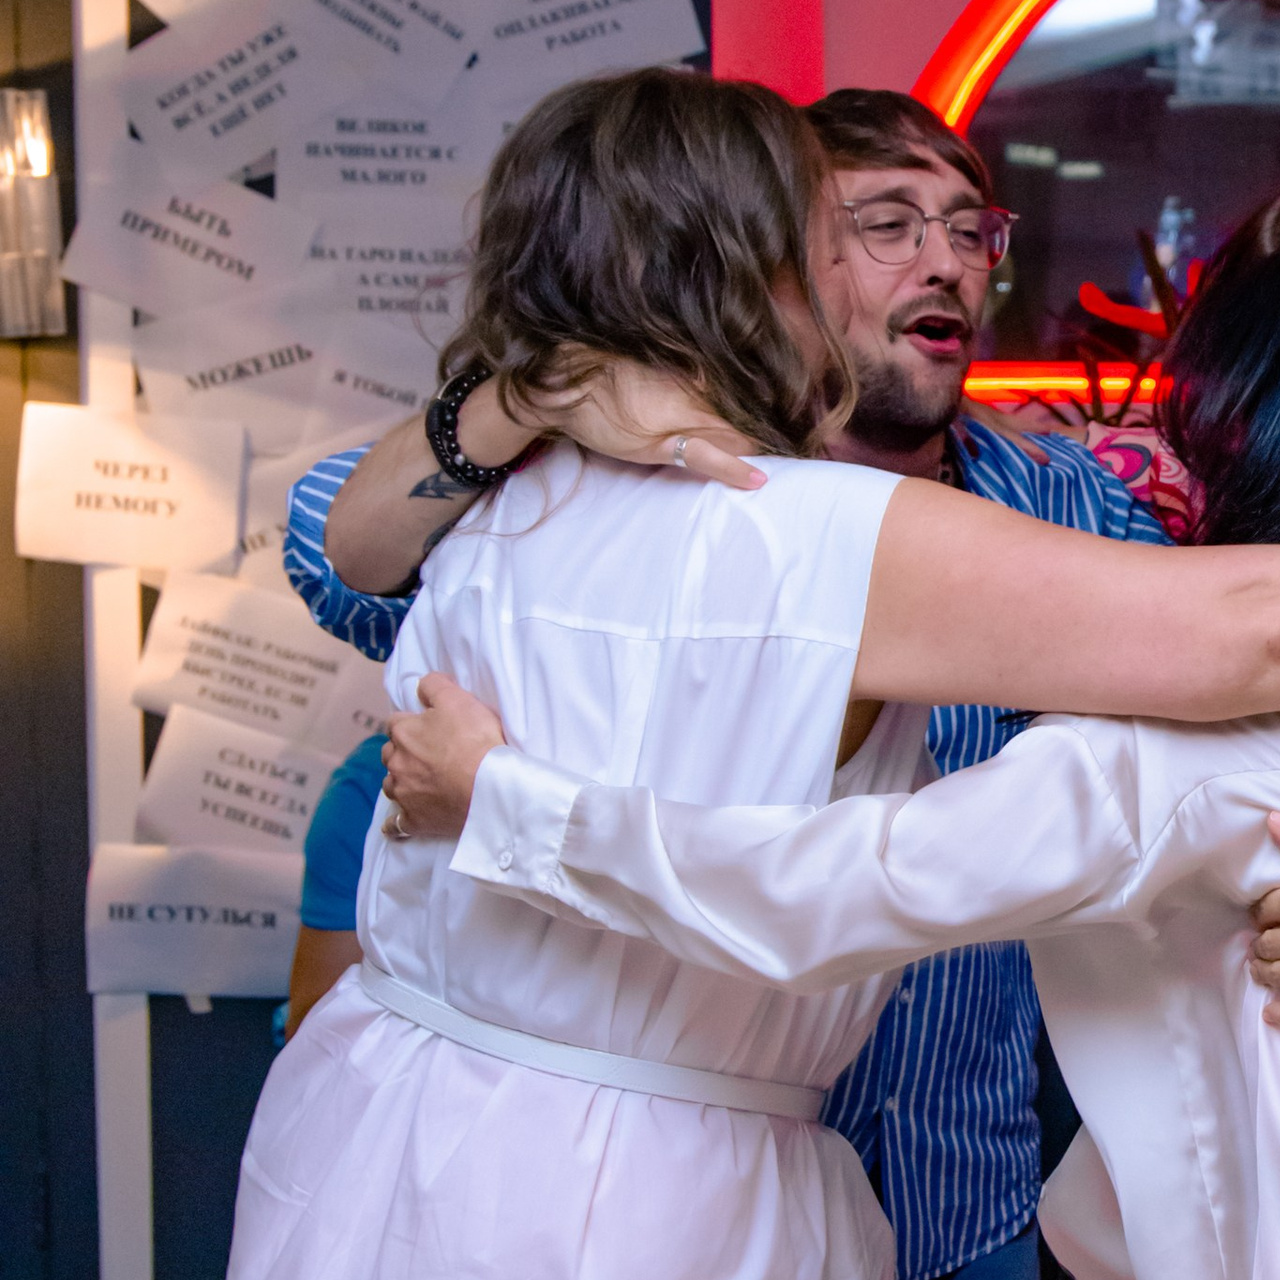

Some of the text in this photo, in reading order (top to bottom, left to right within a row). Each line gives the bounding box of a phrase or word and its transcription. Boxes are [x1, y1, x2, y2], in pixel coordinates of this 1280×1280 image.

[545, 19, 622, 51] РАБОТА
[156, 25, 284, 110] КОГДА ТЫ УЖЕ
[228, 46, 298, 96] НЕДЕЛЯ
[252, 82, 286, 111] НЕТ
[336, 118, 427, 134] ВЕЛИКОЕ
[305, 142, 456, 160] НАЧИНАЕТСЯ С
[340, 169, 427, 184] МАЛОГО
[166, 195, 232, 238] БЫТЬ
[121, 210, 255, 281] ПРИМЕРОМ
[359, 274, 369, 286] А
[373, 273, 419, 287] САМ
[357, 295, 449, 314] ПЛОШАЙ
[186, 344, 313, 390] МОЖЕШЬ
[94, 459, 169, 483] ЧЕРЕЗ
[75, 492, 179, 518] НЕМОГУ
[198, 685, 280, 720] РАБОТАТЬ
[218, 747, 309, 788] СДАТЬСЯ
[203, 770, 309, 816] ТЫ ВСЕГДА
[201, 796, 293, 840] УСПЕЕШЬ
[108, 903, 278, 929] НЕ СУТУЛЬСЯ
